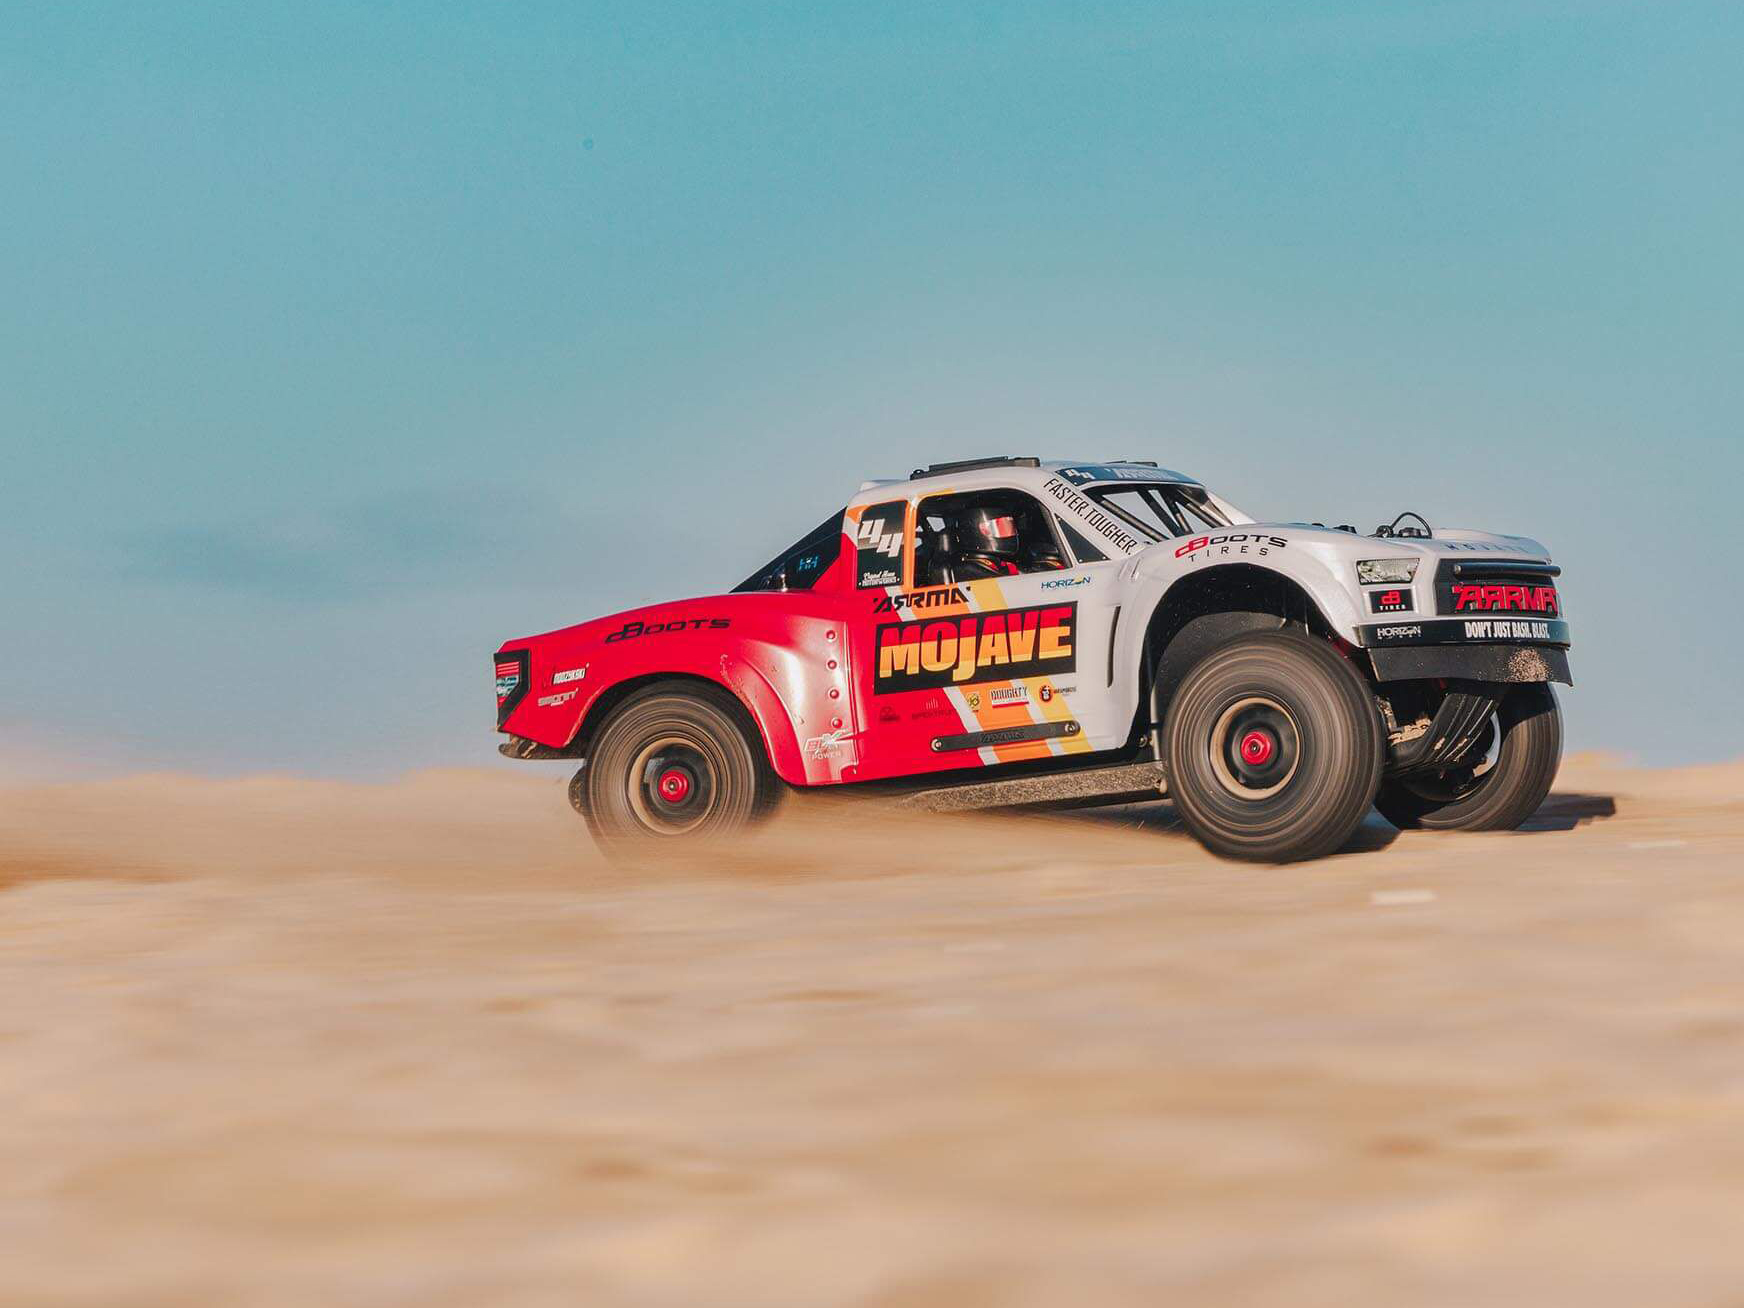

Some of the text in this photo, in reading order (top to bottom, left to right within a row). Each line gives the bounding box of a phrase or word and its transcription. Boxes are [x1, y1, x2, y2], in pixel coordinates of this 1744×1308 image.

[1043, 478, 1139, 556] FASTER. TOUGHER.
[858, 518, 904, 558] 44
[1188, 545, 1269, 563] TIRES
[879, 605, 1074, 683] MOJAVE
[1464, 621, 1492, 639] DON'T
[1493, 621, 1511, 639] JUST
[1512, 622, 1532, 639] BASH.
